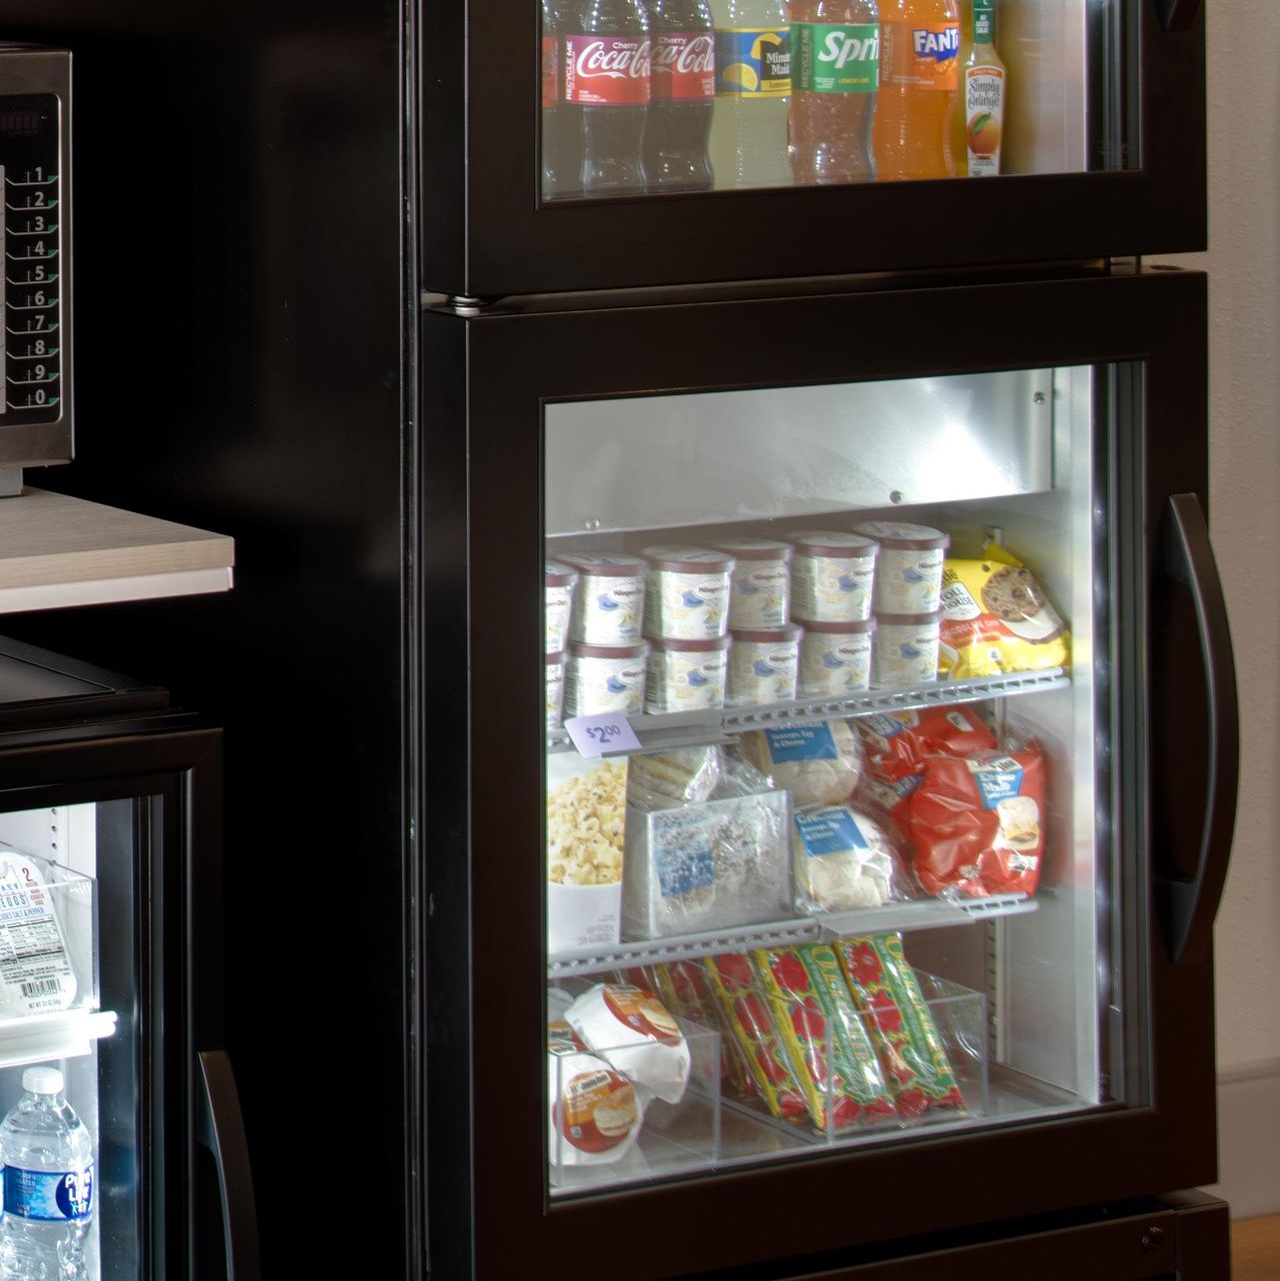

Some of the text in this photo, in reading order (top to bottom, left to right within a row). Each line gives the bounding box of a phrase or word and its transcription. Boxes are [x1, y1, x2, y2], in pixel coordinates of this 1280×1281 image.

[612, 41, 639, 50] Cherry
[817, 30, 879, 69] Spri
[913, 28, 959, 52] FANT
